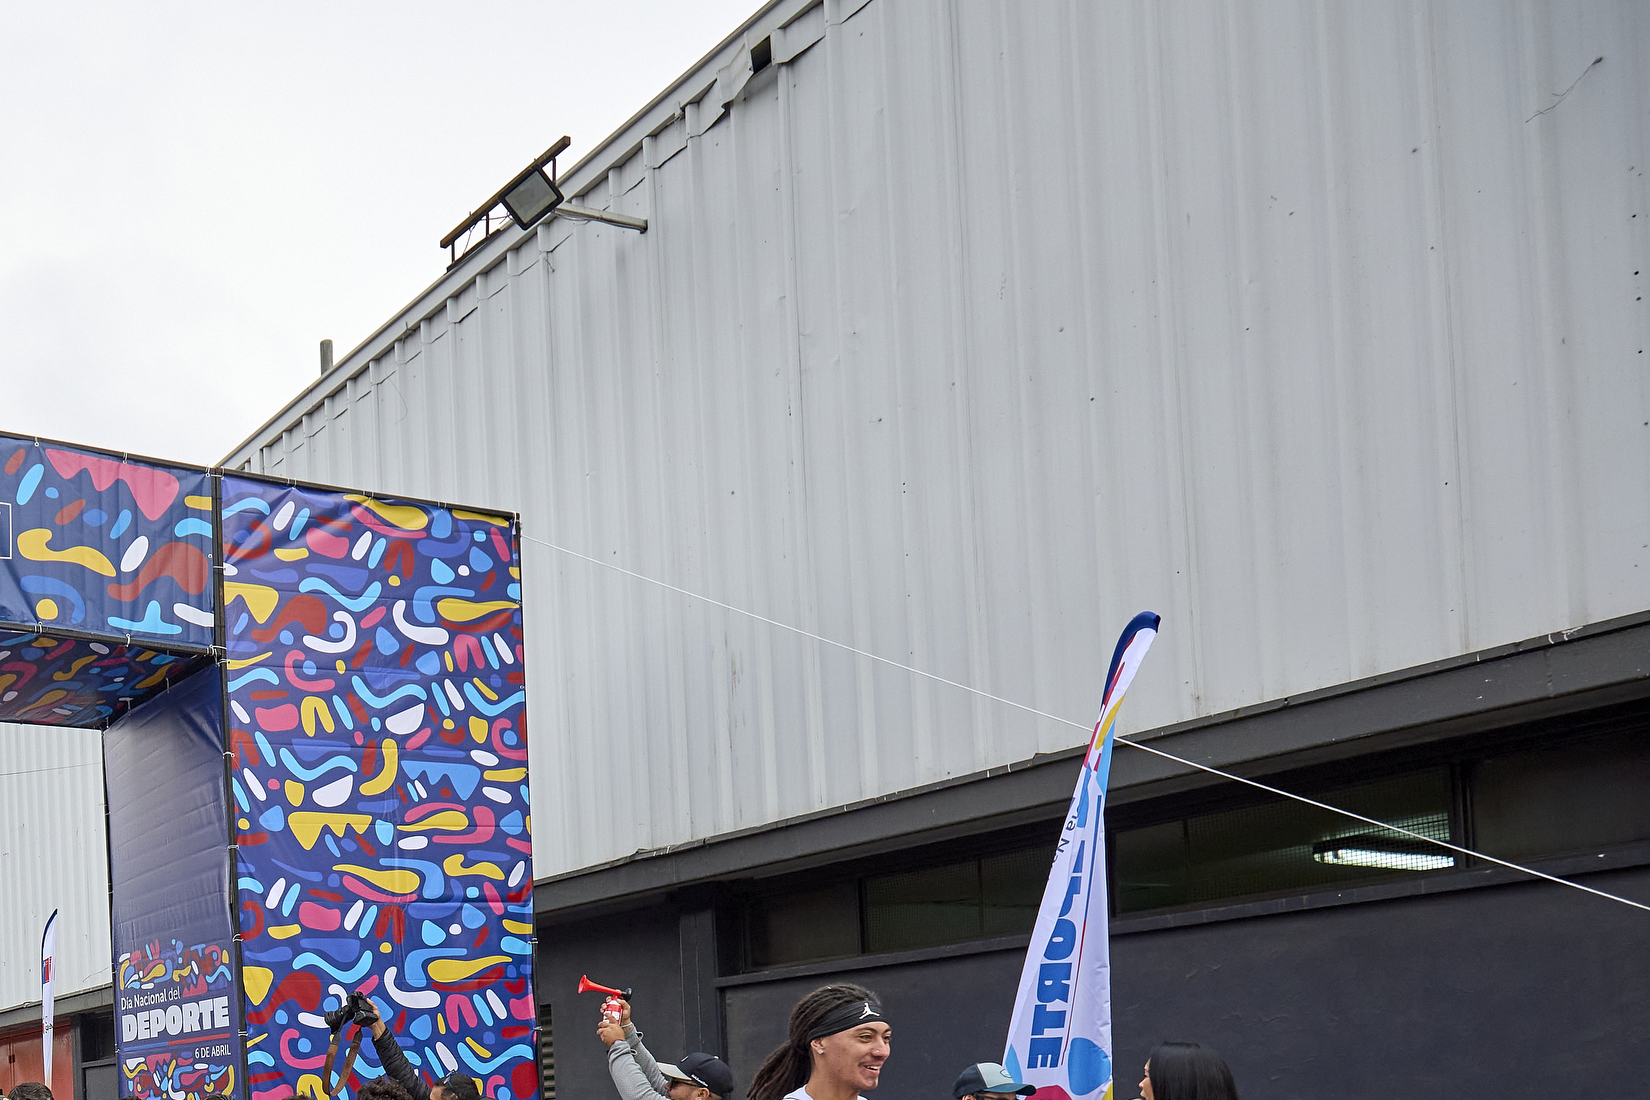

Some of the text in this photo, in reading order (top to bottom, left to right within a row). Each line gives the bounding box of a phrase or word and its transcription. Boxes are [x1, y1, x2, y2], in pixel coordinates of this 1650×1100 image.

[121, 986, 181, 1011] Día Nacional del
[121, 996, 230, 1043] DEPORTE
[195, 1044, 231, 1059] 6 DE ABRIL
